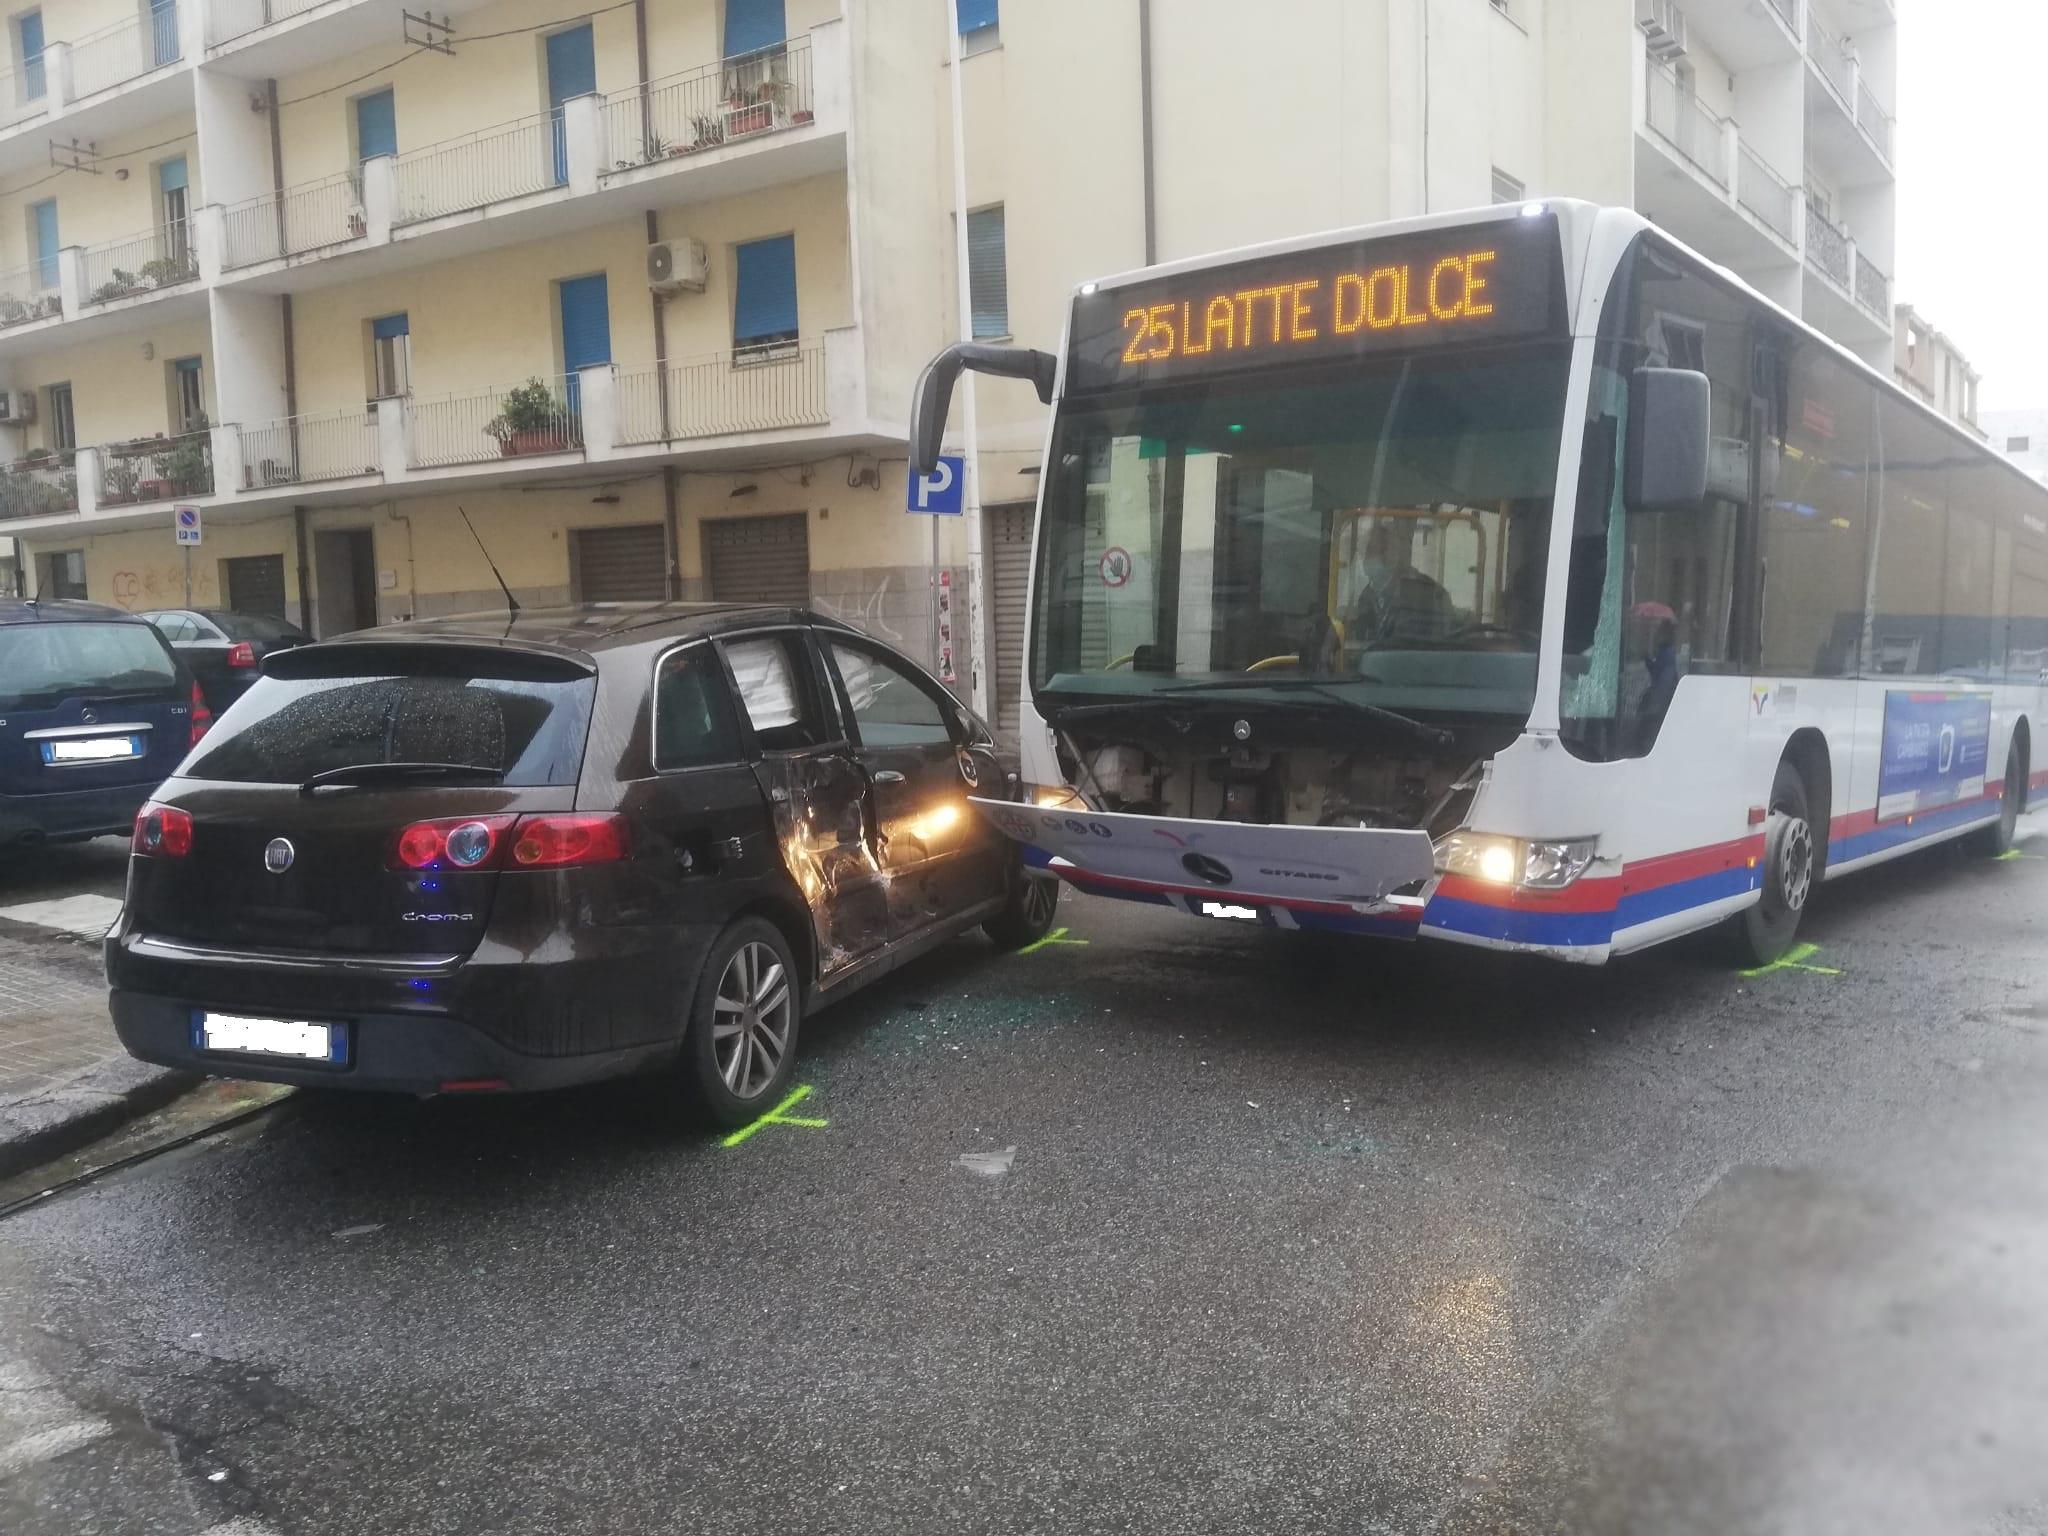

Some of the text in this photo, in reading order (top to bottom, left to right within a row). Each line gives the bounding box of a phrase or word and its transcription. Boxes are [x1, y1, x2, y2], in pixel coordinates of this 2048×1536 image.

[1122, 251, 1495, 363] 25 LATTE DOLCE
[917, 461, 953, 508] P
[270, 848, 287, 864] FIAT
